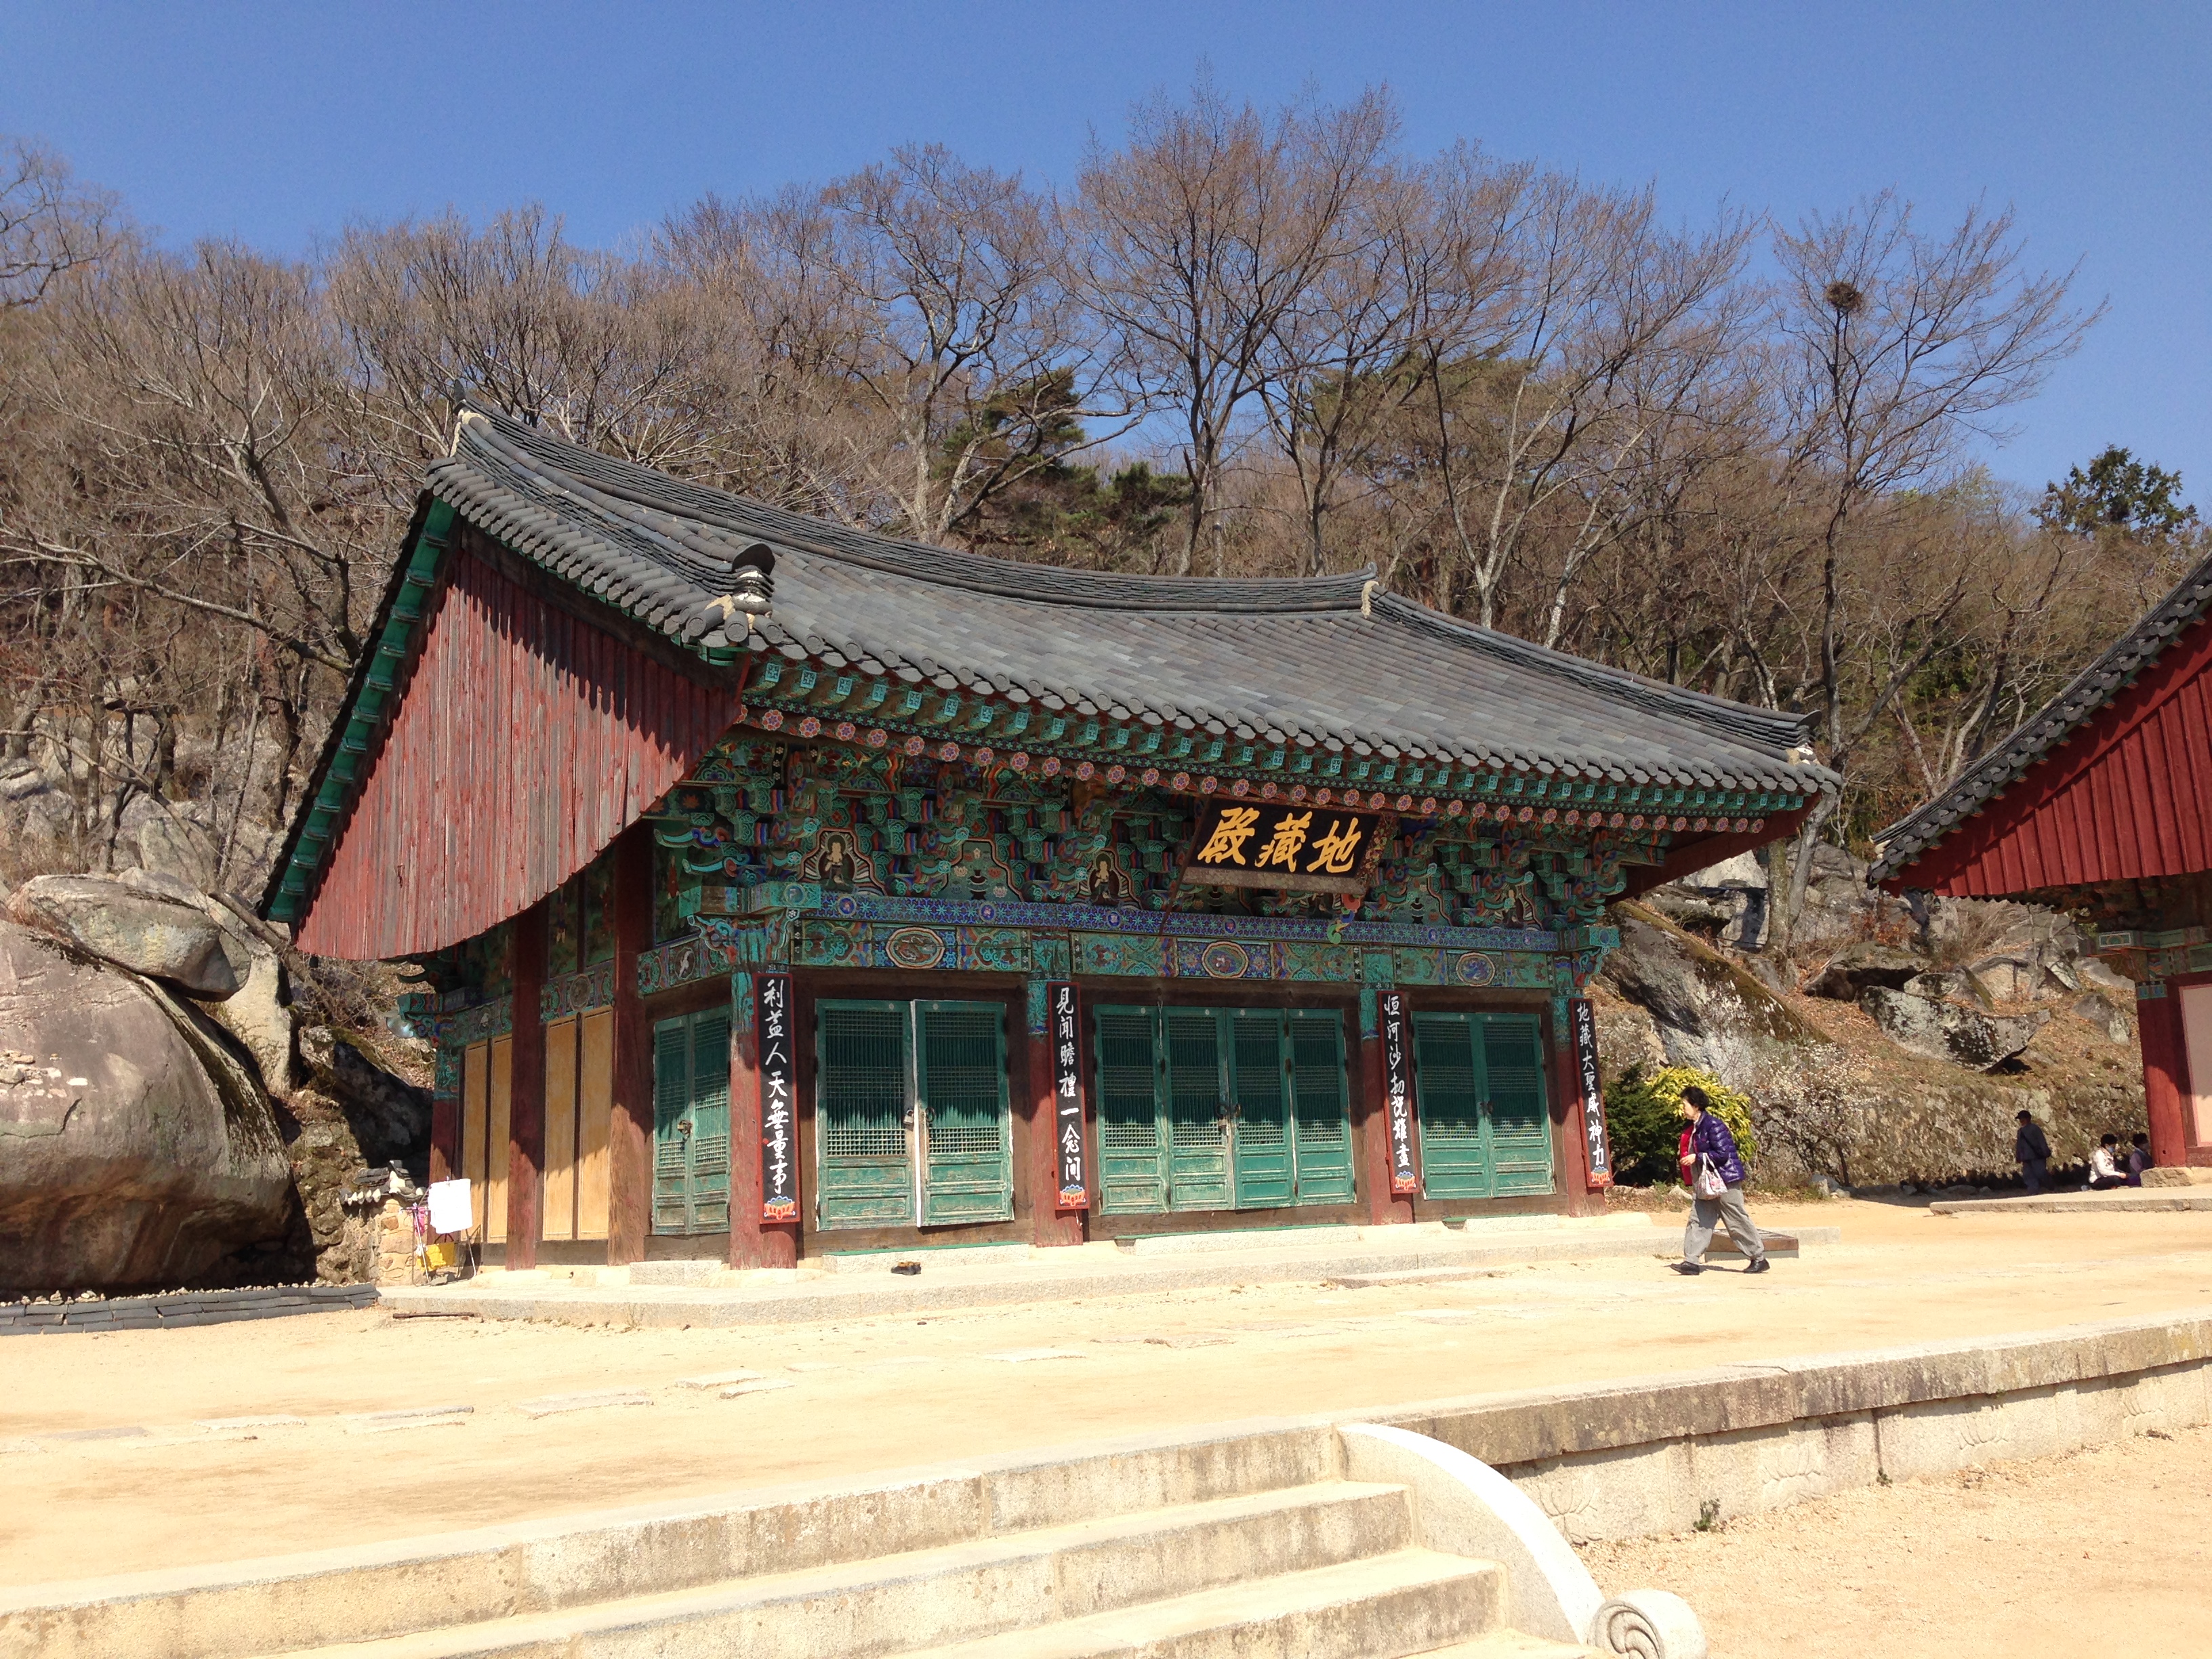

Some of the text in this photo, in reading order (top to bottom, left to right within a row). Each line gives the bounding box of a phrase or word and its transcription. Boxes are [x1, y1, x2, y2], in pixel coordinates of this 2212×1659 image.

[1198, 807, 1361, 873] 地藏殿
[1576, 1002, 1605, 1166] 地藏大聖威神力
